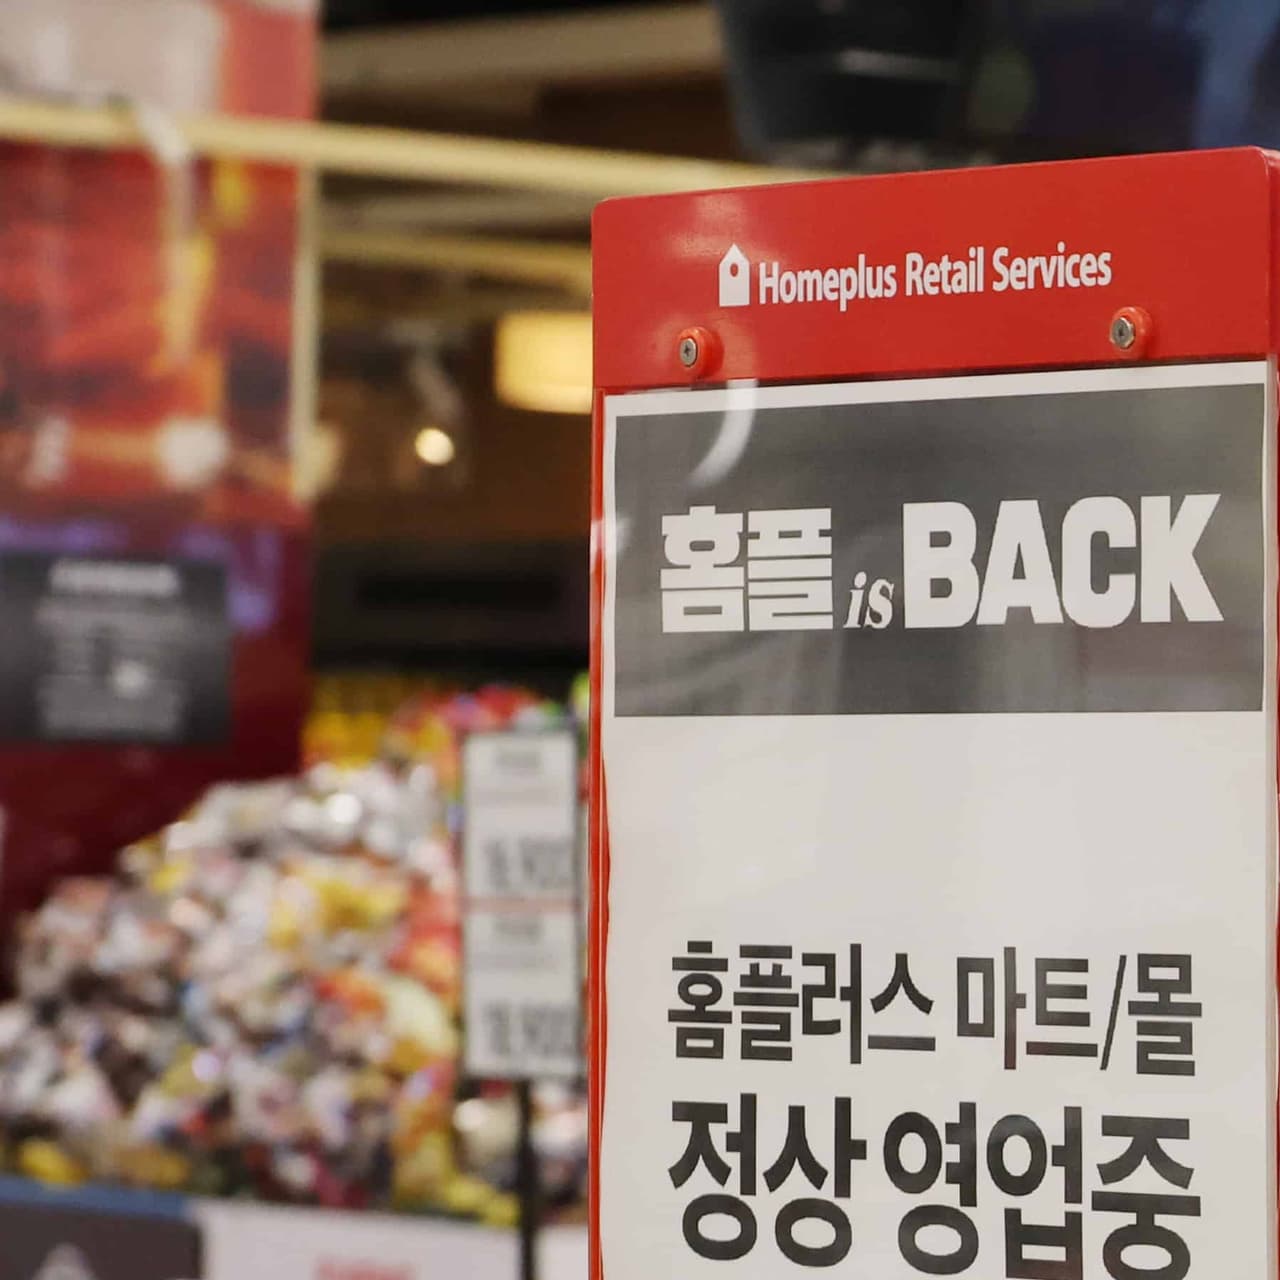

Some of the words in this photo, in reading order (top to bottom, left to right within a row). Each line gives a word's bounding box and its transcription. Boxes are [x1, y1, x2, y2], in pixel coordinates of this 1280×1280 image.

[758, 253, 896, 312] Homeplus
[905, 246, 985, 296] Retail
[992, 241, 1112, 292] Services
[660, 505, 834, 633] 홈플
[843, 571, 895, 629] is
[903, 493, 1224, 629] BACK
[667, 940, 936, 1065] 홈플러스
[956, 946, 1203, 1077] 마트/몰
[667, 1092, 868, 1268] 정상
